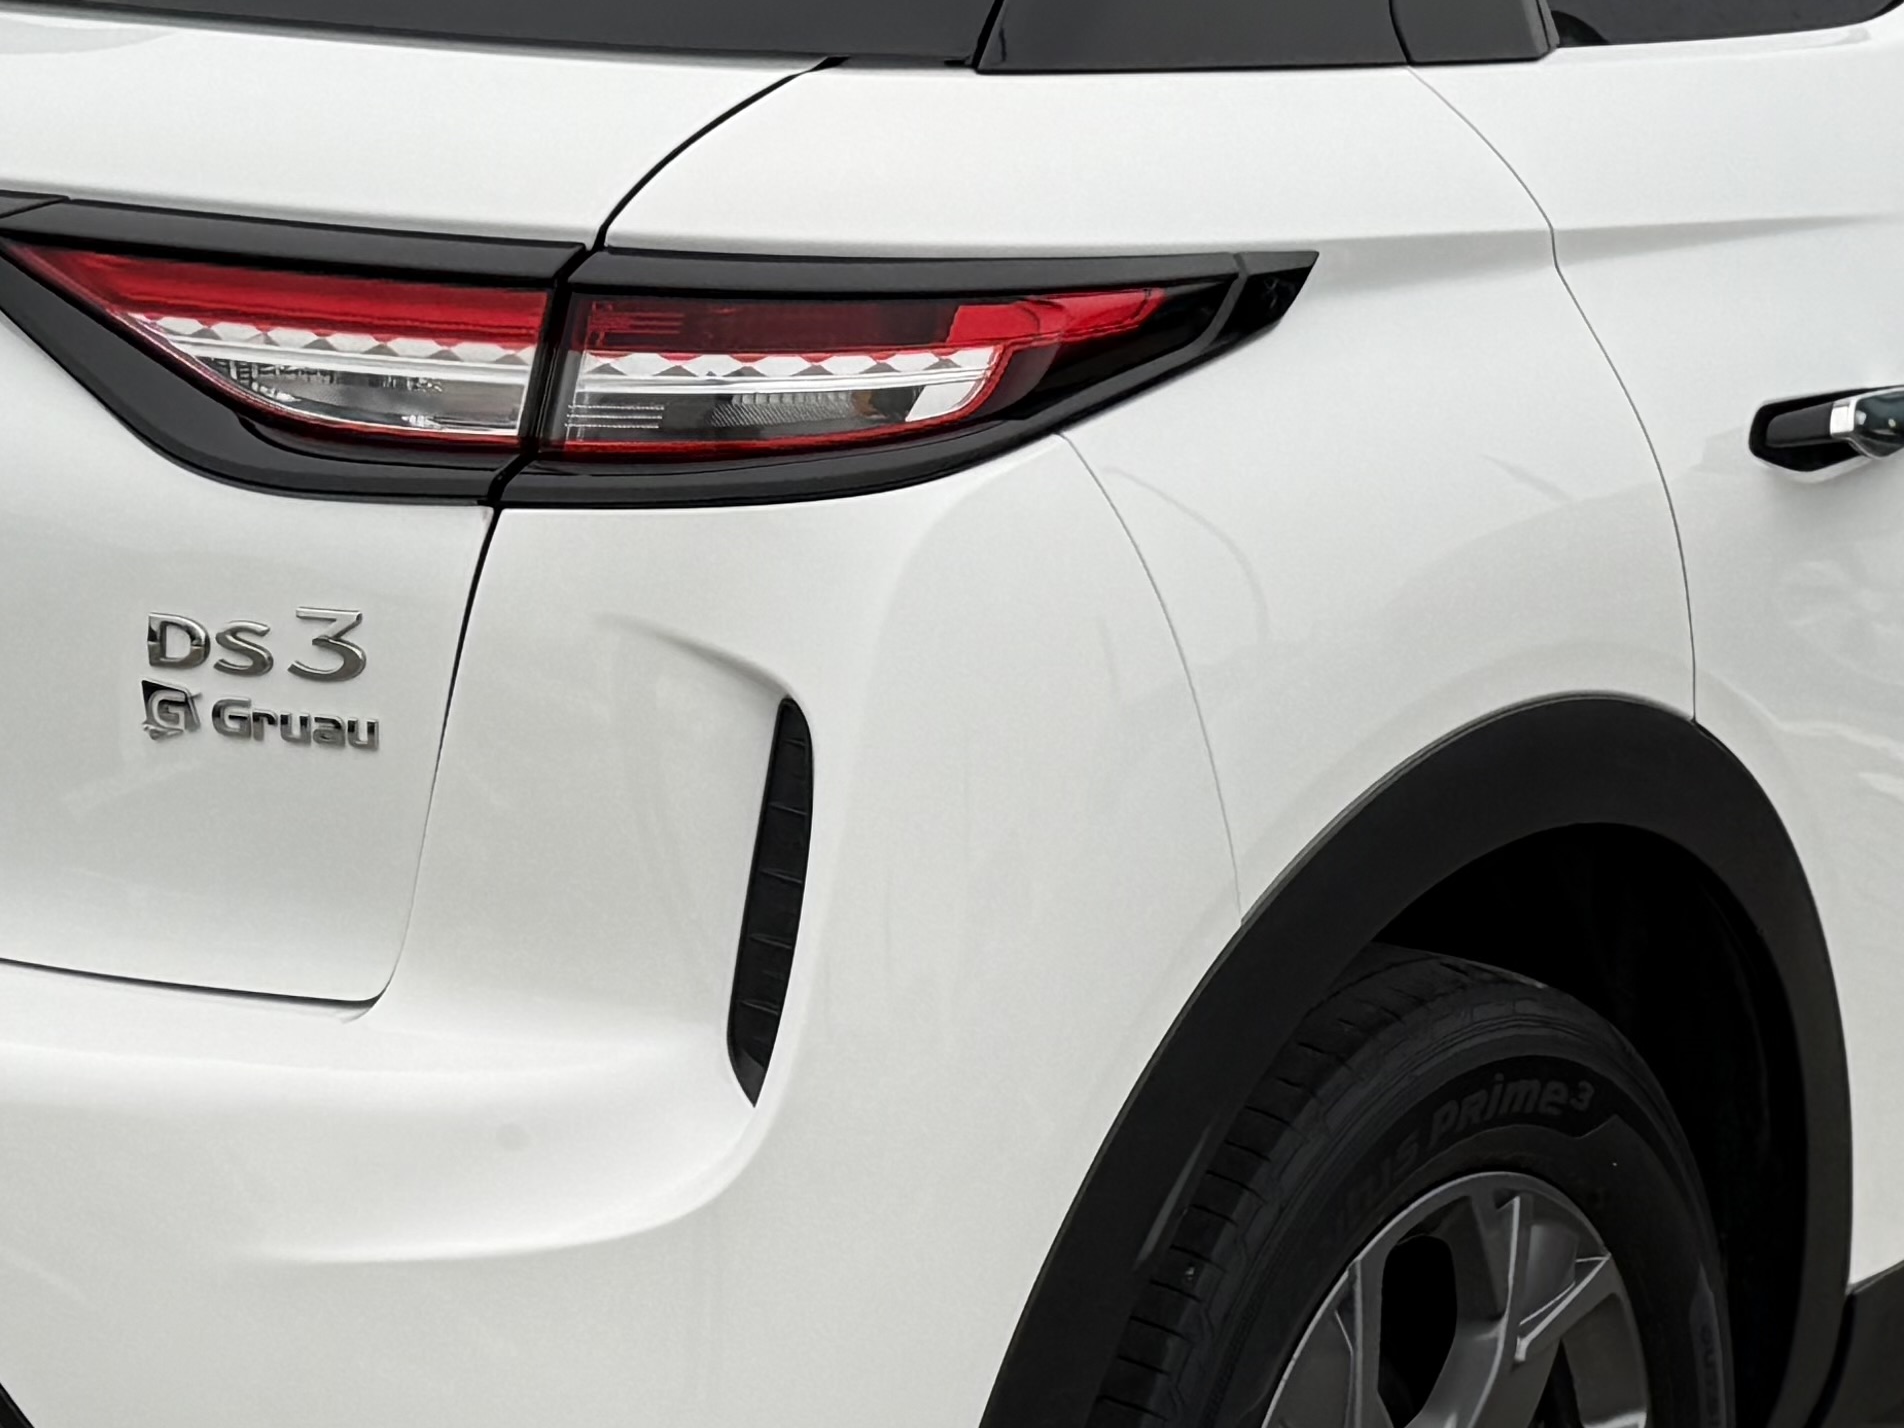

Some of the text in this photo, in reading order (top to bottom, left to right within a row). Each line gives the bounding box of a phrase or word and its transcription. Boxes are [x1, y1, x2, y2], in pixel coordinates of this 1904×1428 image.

[146, 605, 367, 683] DS 3
[211, 696, 380, 752] Gruau
